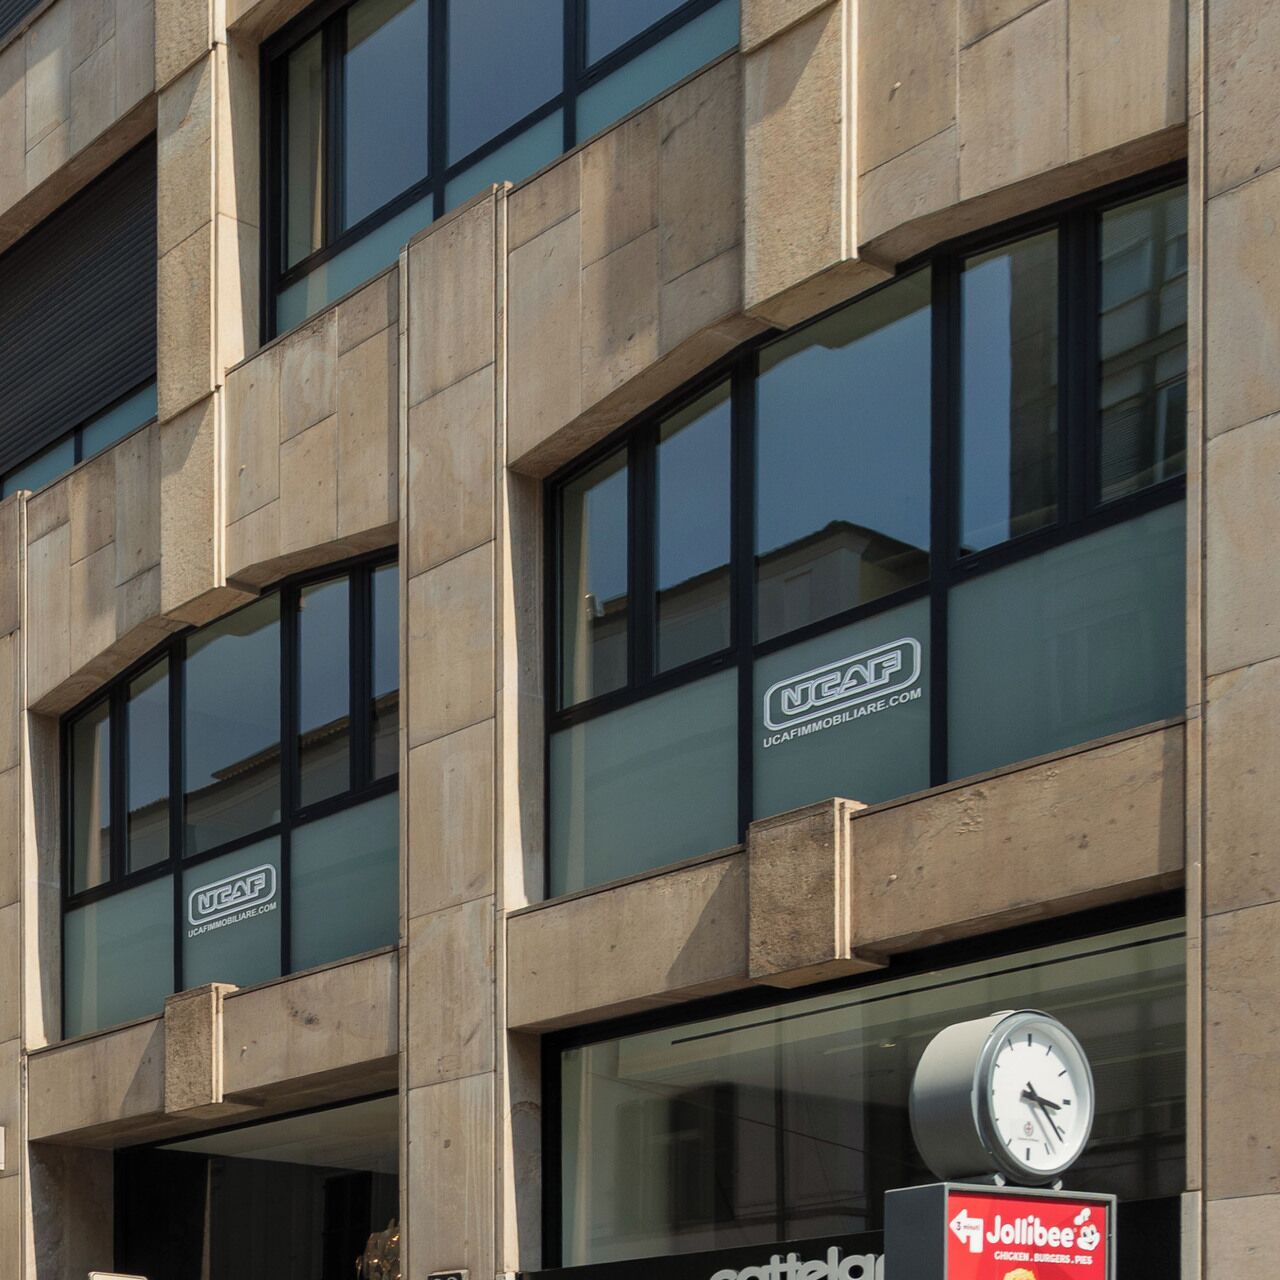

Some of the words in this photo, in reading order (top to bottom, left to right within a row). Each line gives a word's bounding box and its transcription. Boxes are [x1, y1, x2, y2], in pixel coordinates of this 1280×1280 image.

[781, 649, 902, 716] UCAF
[763, 687, 923, 748] UCAFIMMOBILIARE.COM
[197, 872, 266, 915] UCAF
[188, 901, 277, 938] UCAFIMMOBILIARE.COM
[986, 1214, 1074, 1249] Jollibee
[993, 1251, 1030, 1262] CHICKEN
[1033, 1253, 1071, 1264] BURGERS
[1074, 1255, 1093, 1265] PIES
